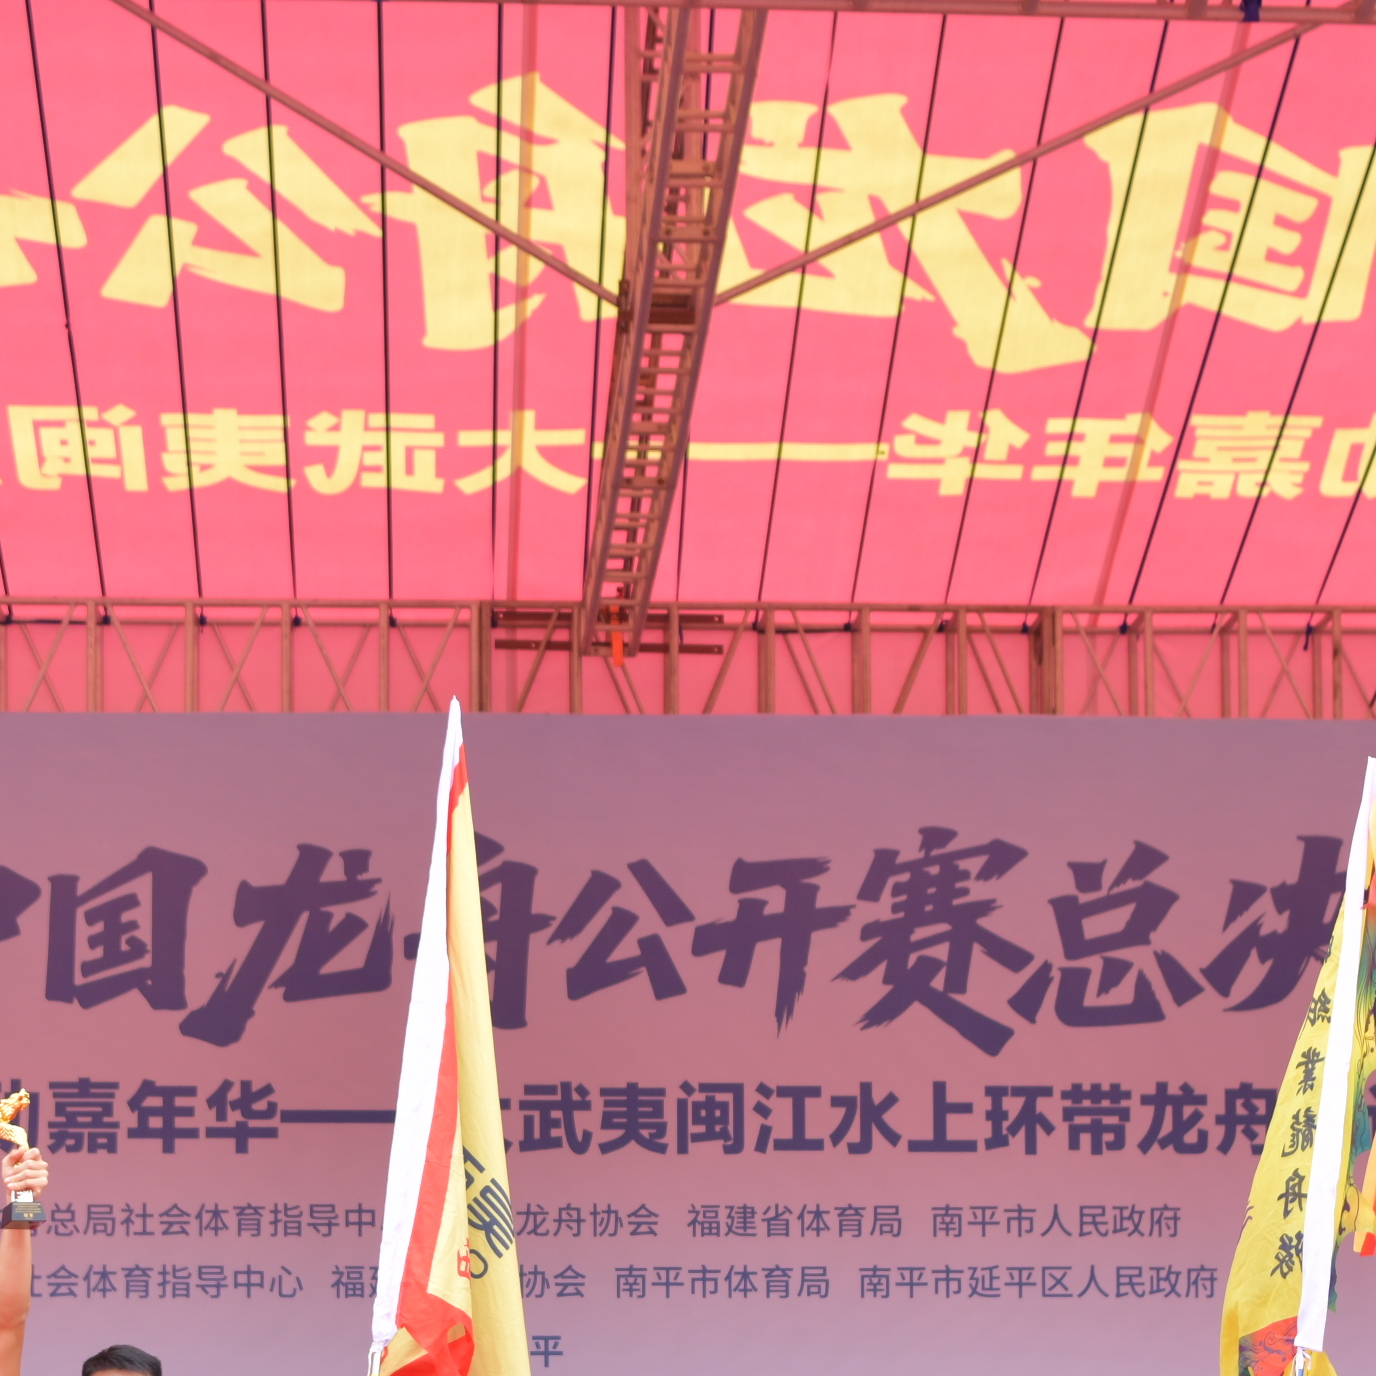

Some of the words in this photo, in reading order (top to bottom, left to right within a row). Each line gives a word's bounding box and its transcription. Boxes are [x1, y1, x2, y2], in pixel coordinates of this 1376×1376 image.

[687, 1203, 903, 1238] 福建省体育局
[931, 1203, 1182, 1238] 南平市人民政府
[615, 1264, 831, 1301] 南平市体育局
[858, 1264, 1219, 1301] 南平市延平区人民政府
